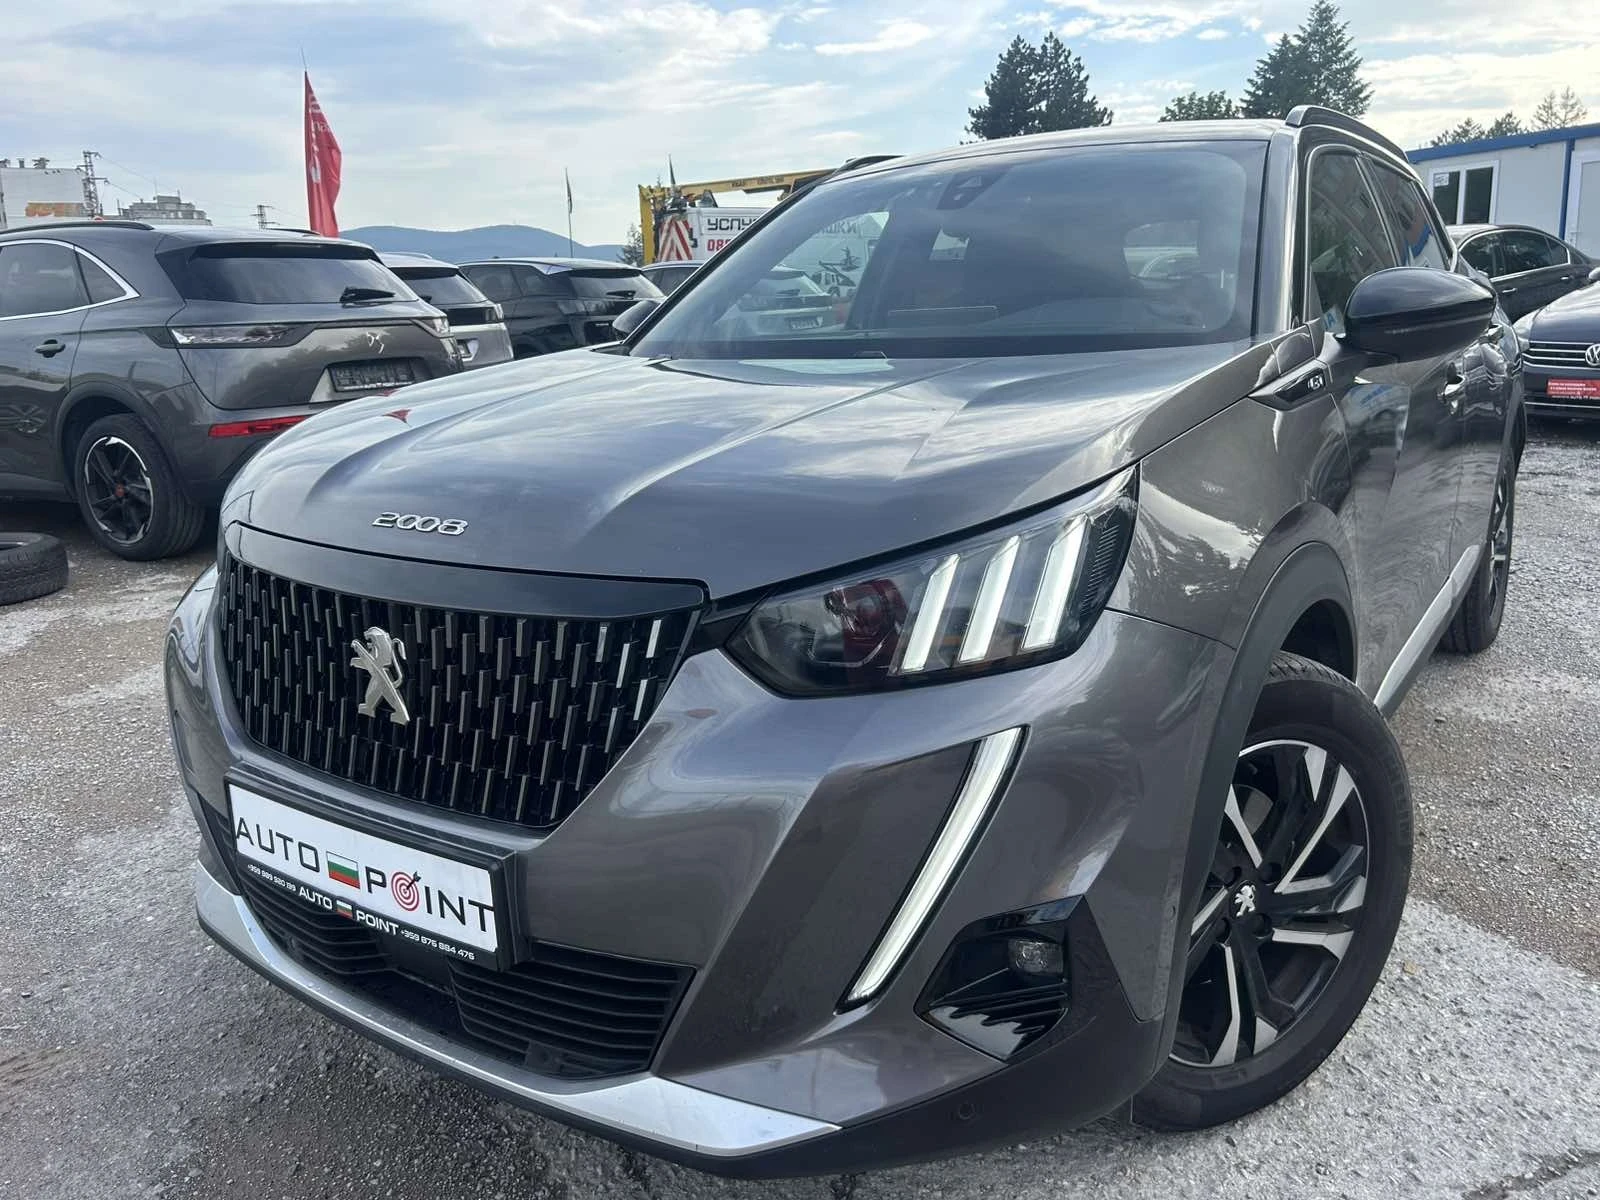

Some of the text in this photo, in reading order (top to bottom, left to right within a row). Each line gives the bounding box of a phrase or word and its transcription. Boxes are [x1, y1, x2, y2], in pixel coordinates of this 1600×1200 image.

[707, 238, 731, 251] 08
[372, 511, 468, 536] 2008
[236, 816, 320, 873] AUTO
[299, 886, 333, 910] AUTO
[356, 909, 399, 935] POINT
